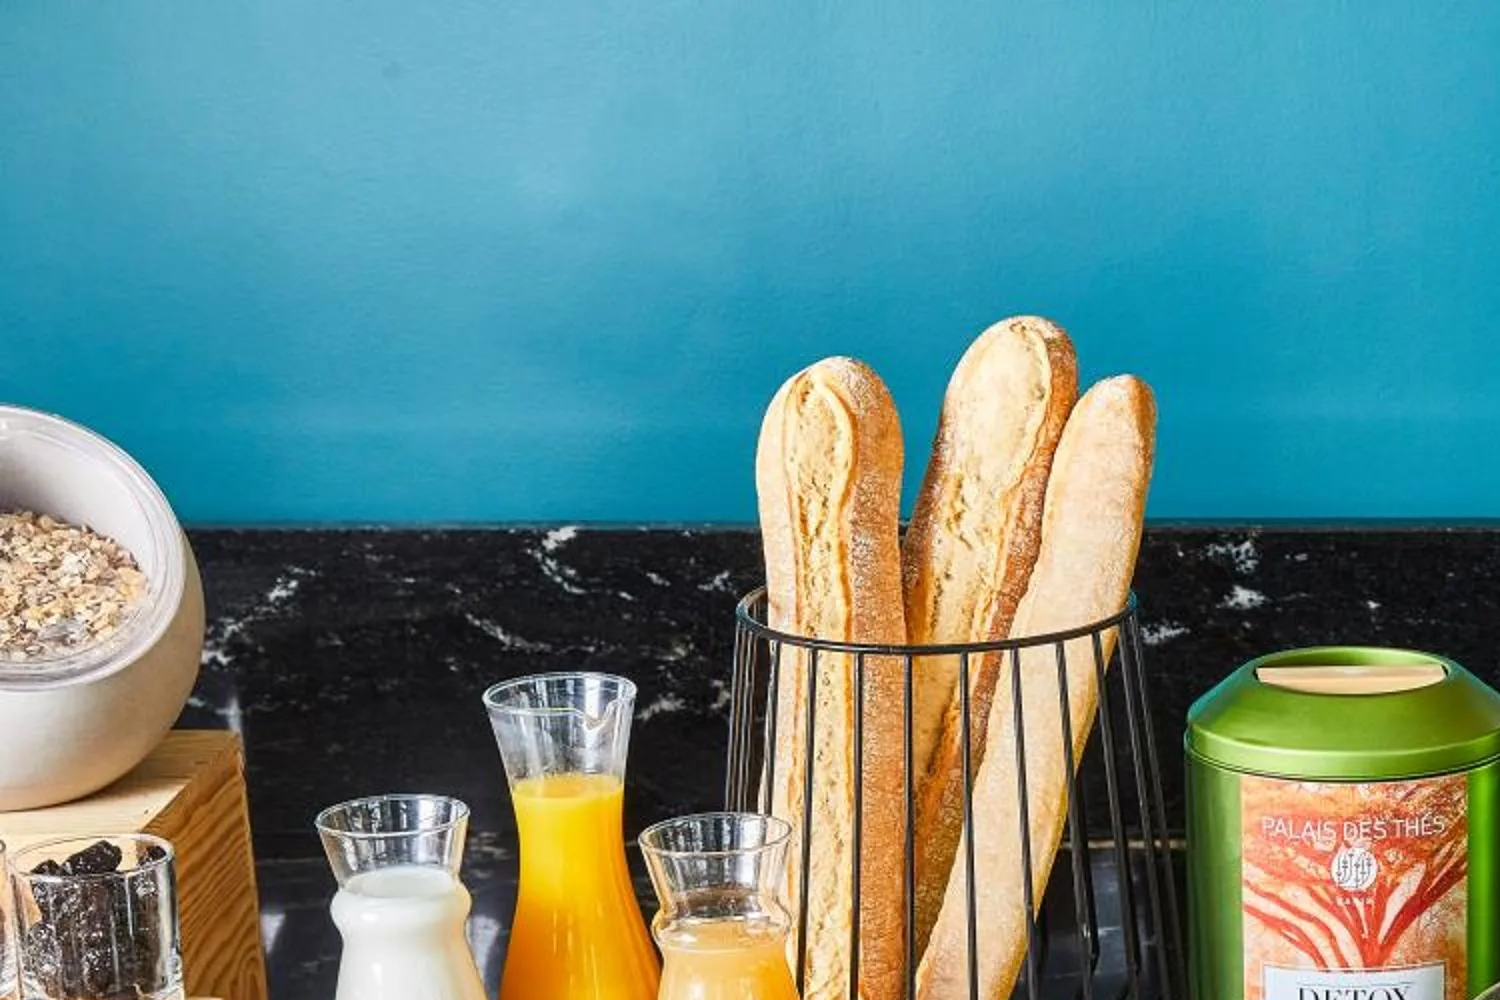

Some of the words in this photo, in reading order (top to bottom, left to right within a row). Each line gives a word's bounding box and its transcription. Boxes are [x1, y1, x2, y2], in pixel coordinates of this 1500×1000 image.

[1262, 817, 1337, 841] PALAIS
[1343, 820, 1387, 840] DES
[1392, 812, 1445, 836] THÉS
